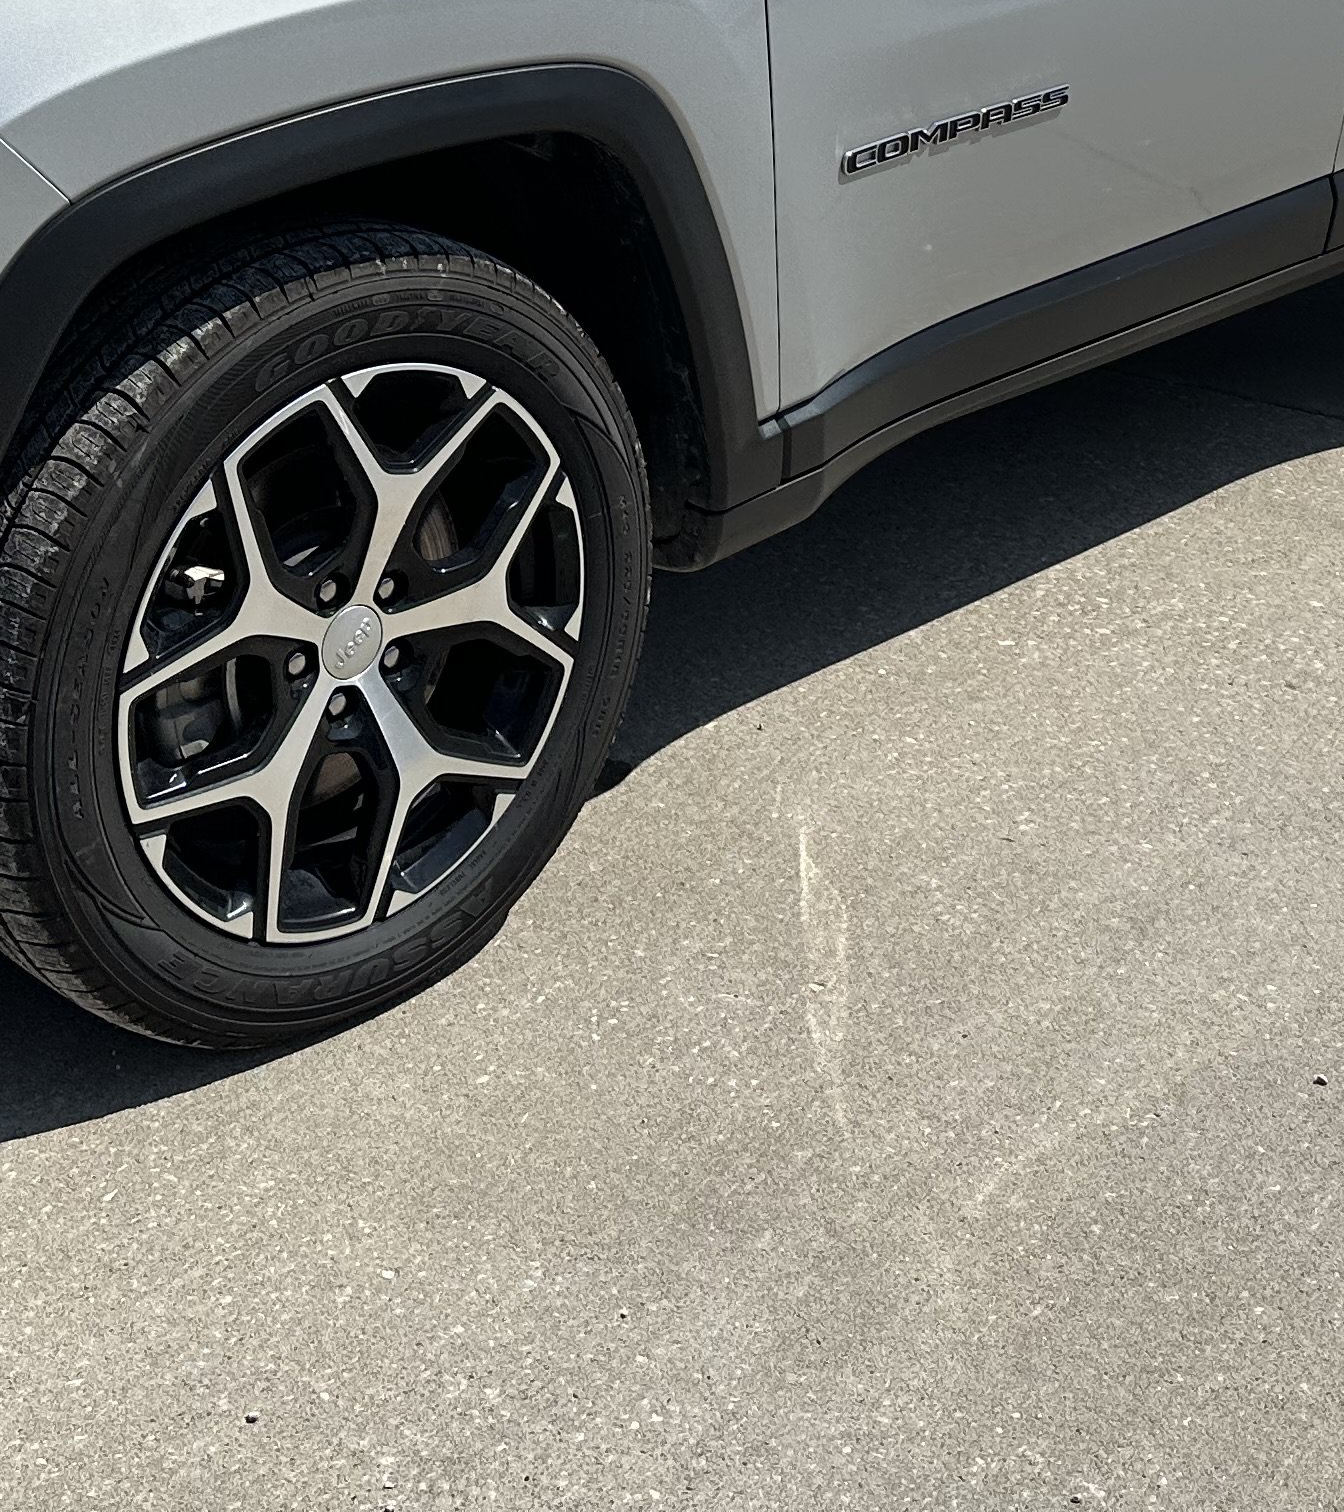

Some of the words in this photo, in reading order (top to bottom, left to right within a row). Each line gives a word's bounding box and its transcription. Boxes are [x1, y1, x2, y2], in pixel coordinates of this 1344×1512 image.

[840, 83, 1070, 176] COMPASS
[255, 308, 561, 395] GOODYEAR
[335, 617, 371, 669] Jeep
[156, 875, 498, 1008] ASSURANCE
